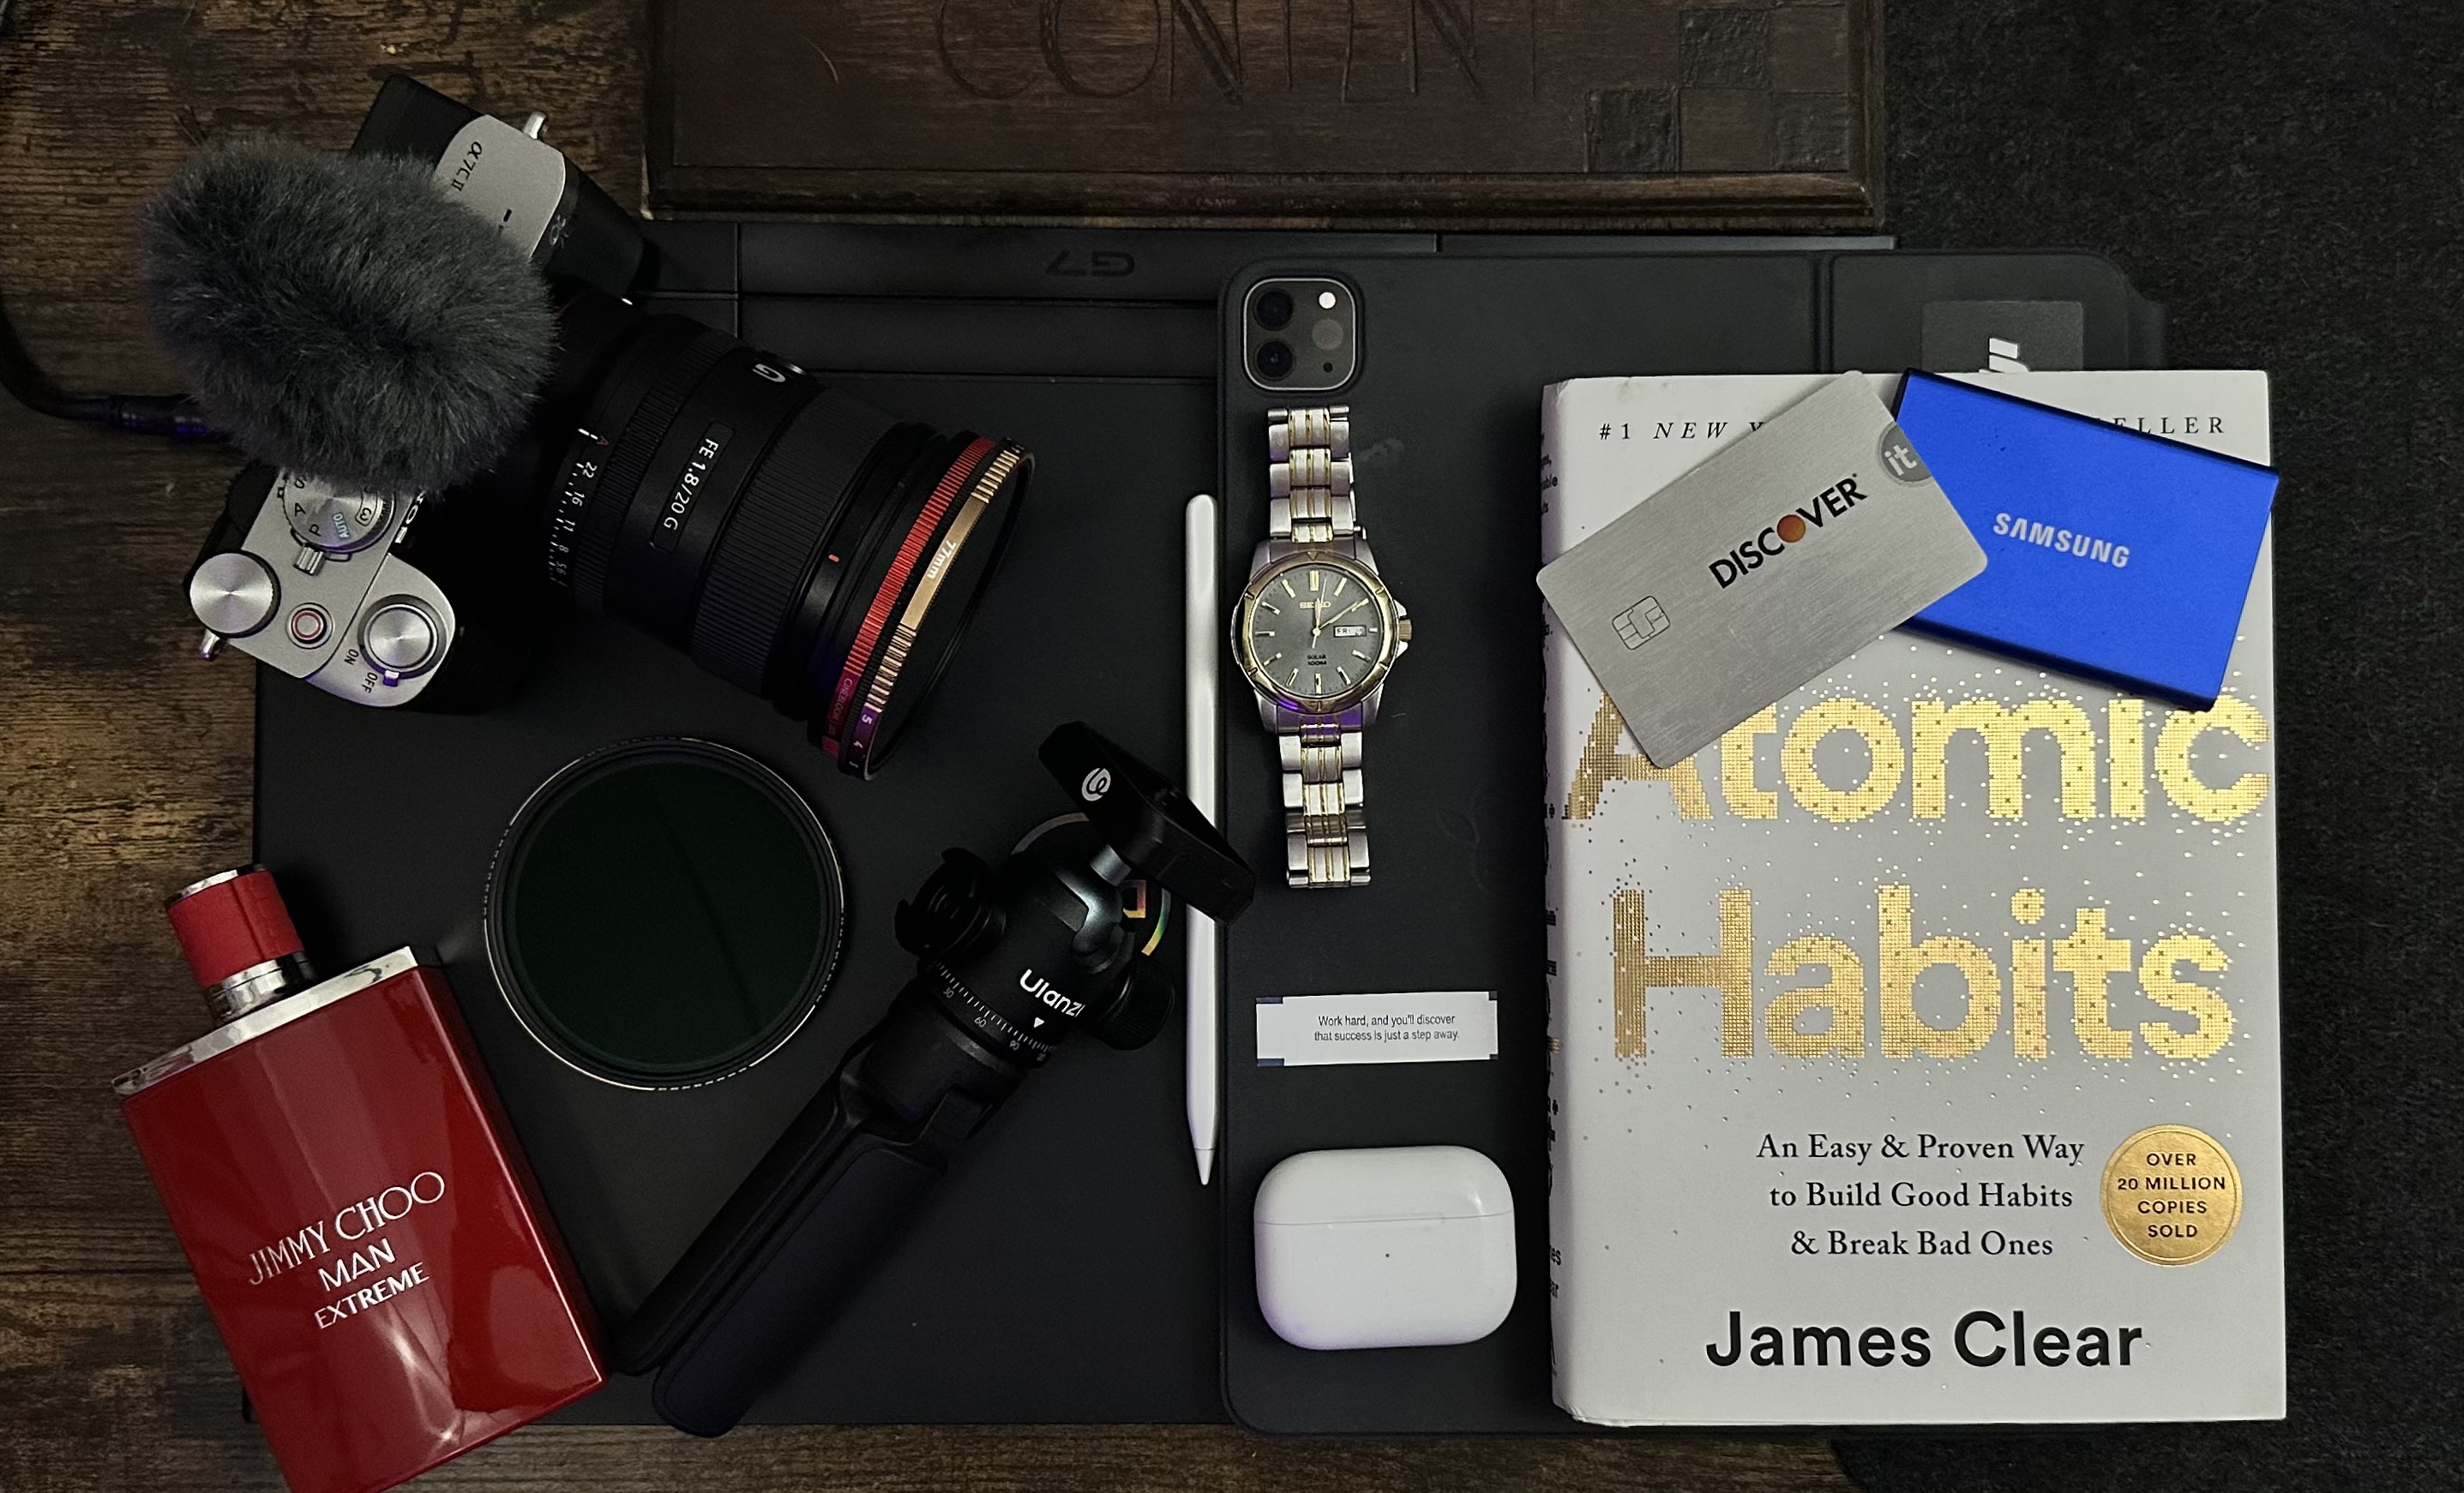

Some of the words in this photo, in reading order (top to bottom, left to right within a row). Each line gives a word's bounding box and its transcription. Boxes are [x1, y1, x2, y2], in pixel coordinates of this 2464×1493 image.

[1043, 249, 1135, 277] G7
[751, 363, 786, 383] G
[1599, 423, 1631, 441] #1
[1653, 422, 1728, 440] NEW
[699, 438, 719, 459] FE
[582, 461, 598, 478] 22
[1884, 444, 1917, 477] it
[671, 462, 706, 514] 1.8/20
[293, 502, 307, 517] A
[571, 491, 585, 507] 16
[309, 524, 322, 537] P
[333, 513, 351, 539] AUTO
[562, 519, 576, 532] 11
[664, 516, 678, 531] G
[1708, 477, 1867, 590] DISCOVER
[558, 544, 569, 554] 8
[1992, 513, 2130, 568] SAMSUNG
[927, 539, 957, 580] 77mm
[344, 649, 359, 665] ON
[362, 672, 378, 693] OFF
[862, 713, 874, 725] 5
[1565, 690, 2271, 823] Atomic
[1613, 884, 2233, 1059] Habits
[1019, 968, 1085, 1017] Ulanzi
[974, 1016, 987, 1028] 60
[1318, 1015, 1343, 1027] Work
[1344, 1015, 1369, 1028] hard,
[1371, 1014, 1389, 1026] and
[1391, 1014, 1415, 1028] you'll
[1416, 1014, 1456, 1025] discover
[1313, 1030, 1332, 1041] that
[1334, 1031, 1372, 1041] success
[1374, 1030, 1382, 1040] is
[1384, 1030, 1401, 1043] just
[1403, 1032, 1409, 1040] a
[1411, 1029, 1432, 1042] step
[1433, 1030, 1459, 1041] away.
[1756, 1133, 1799, 1159] An
[1807, 1133, 1872, 1166] Easy
[1880, 1134, 1909, 1159] &
[1917, 1133, 2015, 1159] Proven
[2022, 1134, 2085, 1166] Way
[2146, 1153, 2197, 1166] OVER
[2117, 1178, 2138, 1190] 20
[2145, 1176, 2226, 1190] MILLION
[1770, 1186, 1797, 1207] to
[1806, 1181, 1882, 1207] Build
[1890, 1181, 1969, 1207] Good
[1978, 1181, 2073, 1207] Habits
[2137, 1200, 2208, 1214] COPIES
[249, 1220, 331, 1286] JIMMY
[334, 1171, 445, 1240] CHOO
[2148, 1224, 2198, 1238] SOLD
[1791, 1230, 1820, 1256] &
[1827, 1230, 1910, 1256] Break
[1917, 1230, 1972, 1256] Bad
[1980, 1230, 2054, 1256] Ones
[317, 1238, 396, 1292] MAN
[314, 1262, 430, 1329] EXTREME
[1705, 1310, 1932, 1367] James
[1954, 1310, 2142, 1367] Clear
